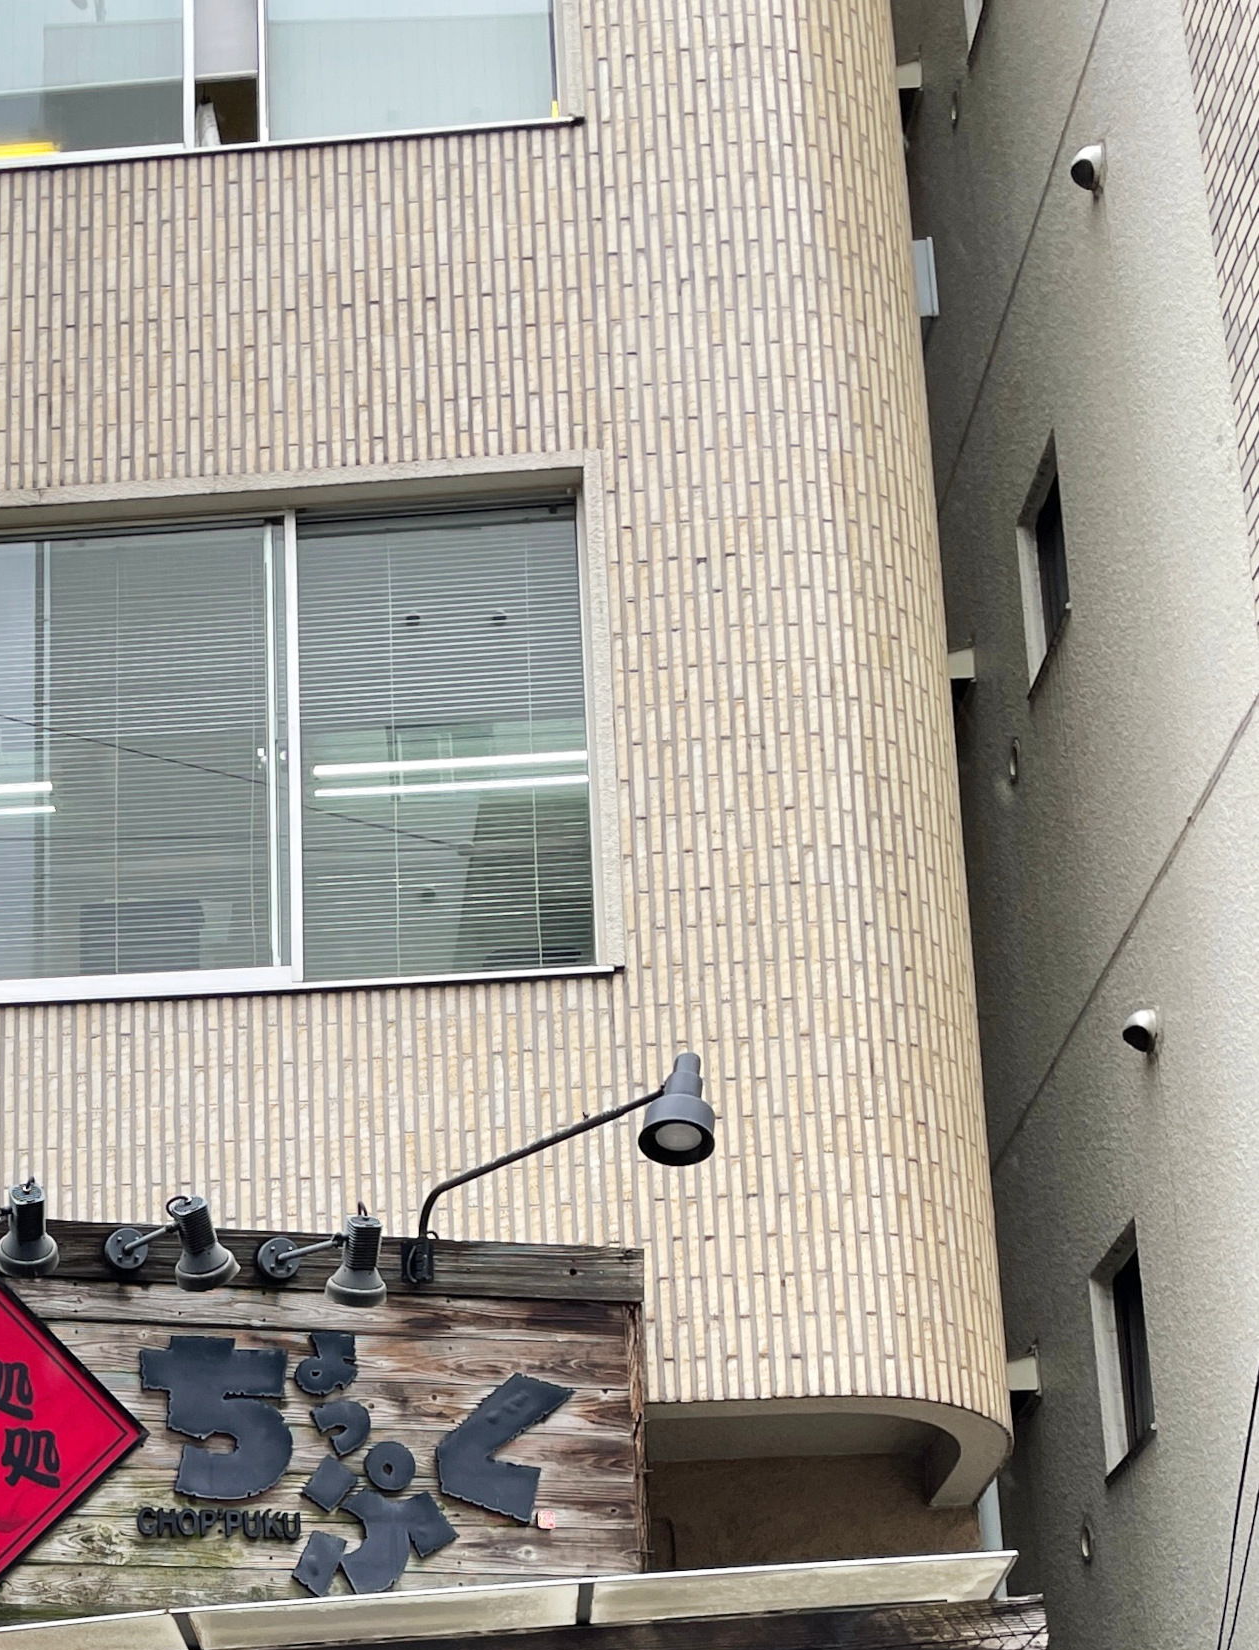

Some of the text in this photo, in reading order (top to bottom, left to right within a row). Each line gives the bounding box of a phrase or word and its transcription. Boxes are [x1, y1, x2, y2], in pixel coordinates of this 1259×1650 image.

[140, 1331, 577, 1598] ちょっぷく
